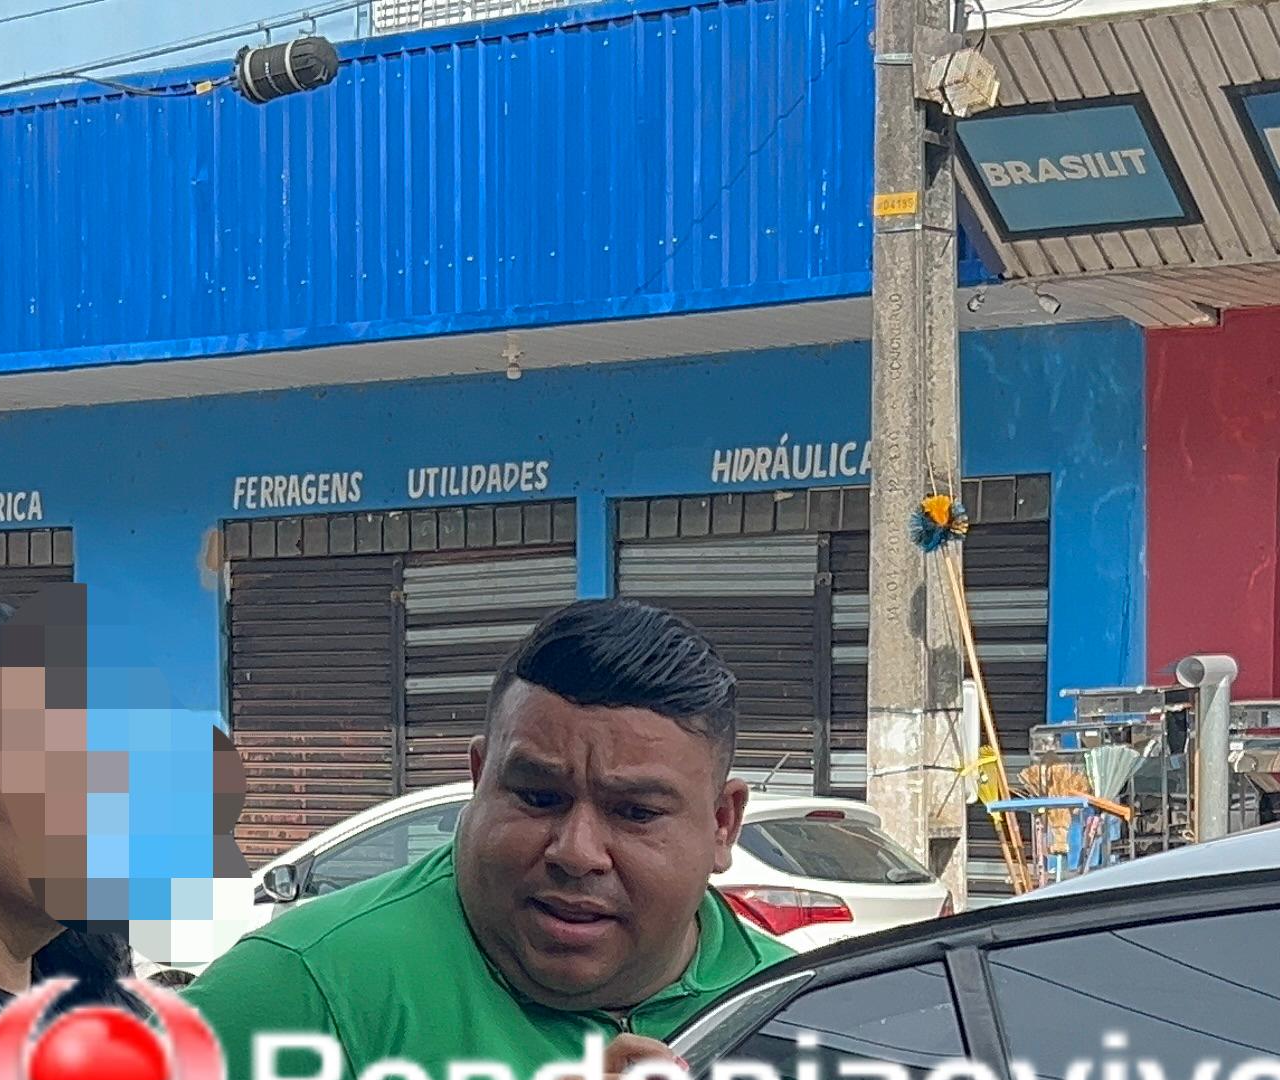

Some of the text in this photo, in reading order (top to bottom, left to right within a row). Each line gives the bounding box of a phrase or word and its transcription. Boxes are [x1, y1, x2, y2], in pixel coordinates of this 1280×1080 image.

[979, 148, 1146, 188] BRASILIT
[233, 461, 549, 510] FERRAGENS UTILIDADES
